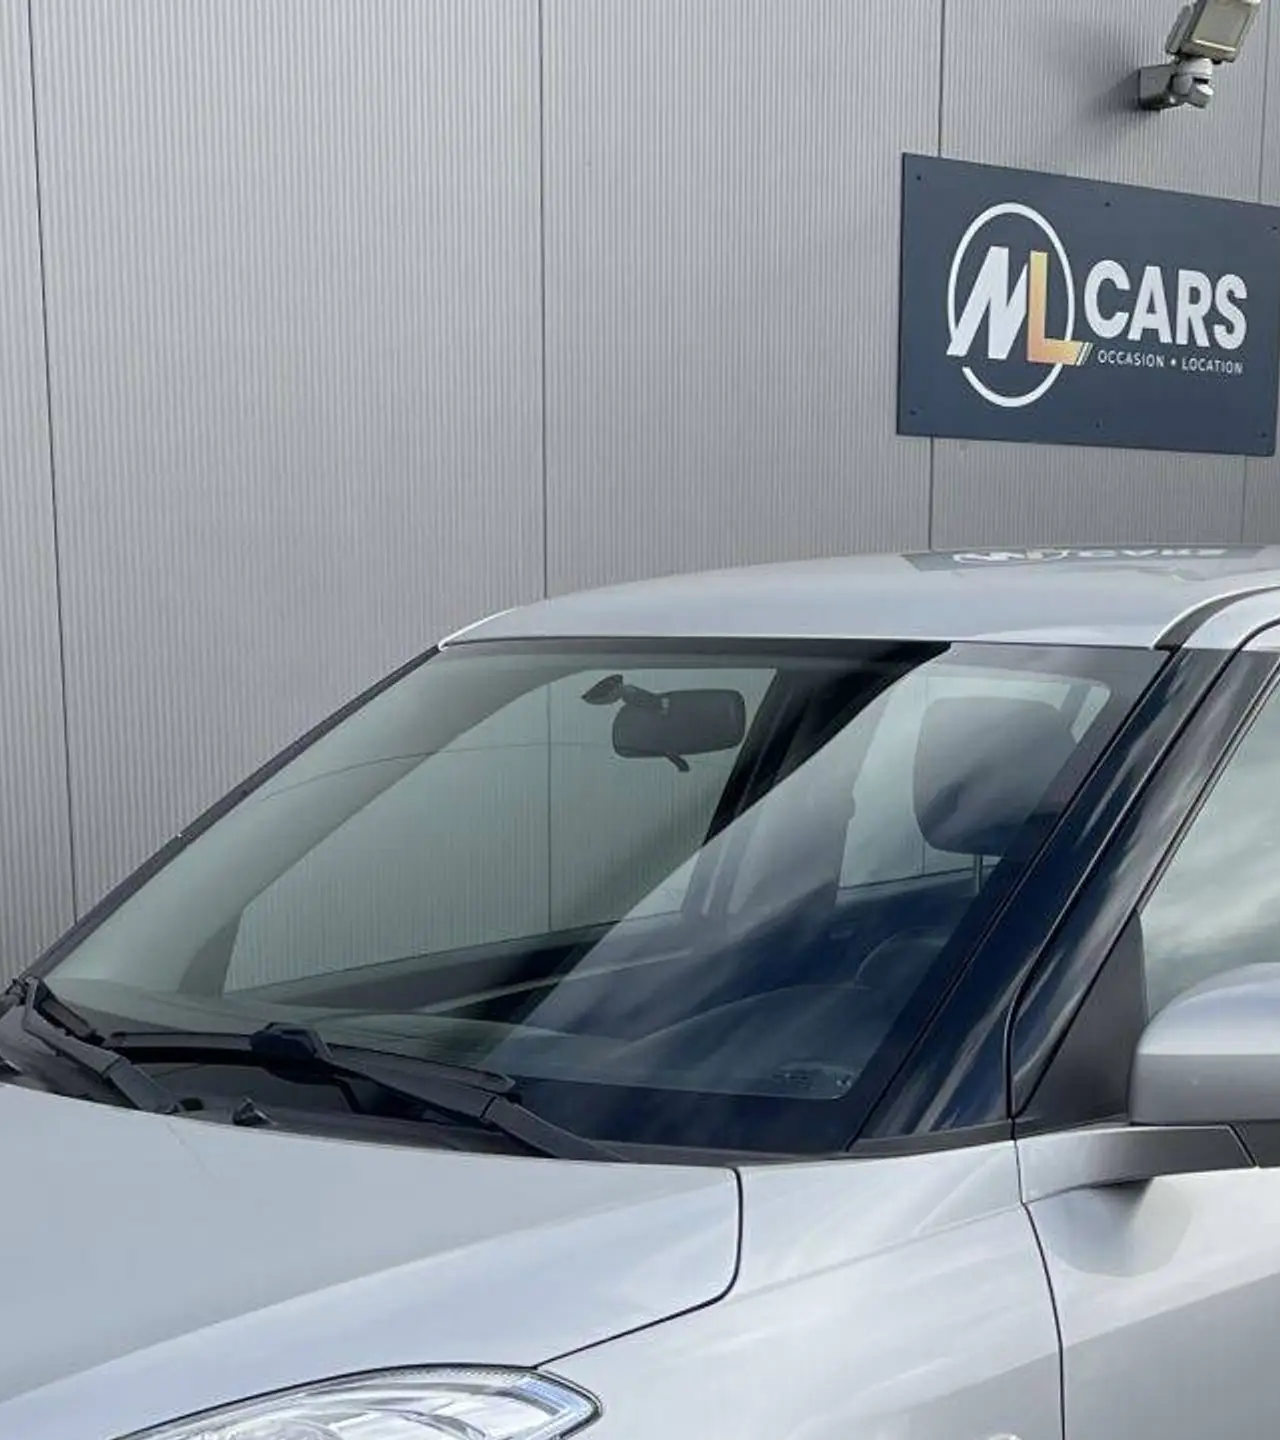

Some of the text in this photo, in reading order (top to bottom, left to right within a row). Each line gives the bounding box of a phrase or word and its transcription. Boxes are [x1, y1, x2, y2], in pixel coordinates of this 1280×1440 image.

[946, 246, 1248, 366] ML CARS
[1098, 349, 1244, 376] OCCASION LOCATION
